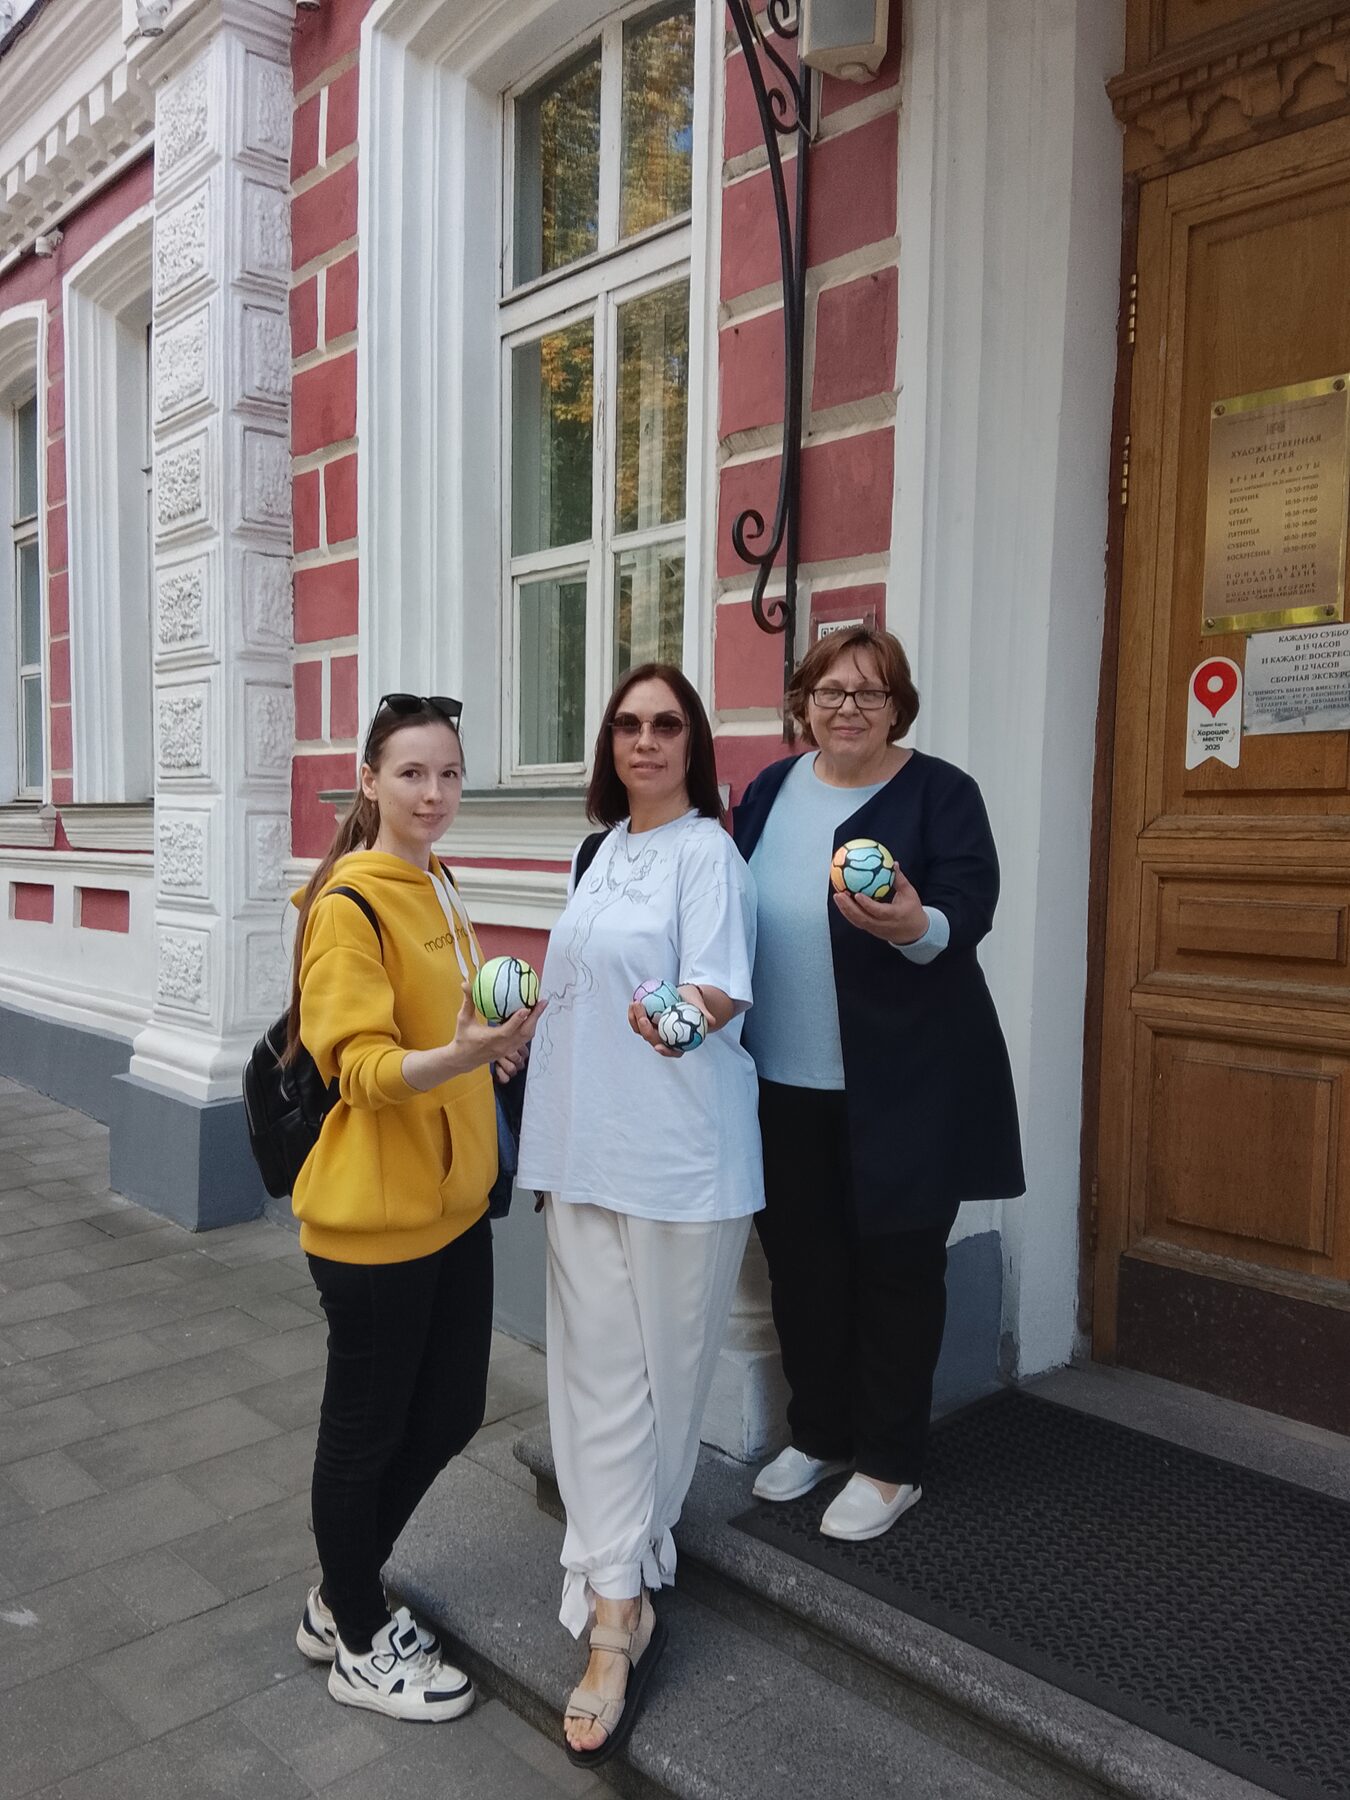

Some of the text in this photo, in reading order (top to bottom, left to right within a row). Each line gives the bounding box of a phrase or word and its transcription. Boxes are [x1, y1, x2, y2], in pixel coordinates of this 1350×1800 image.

[1231, 433, 1322, 459] ХУДОЖЕСТВЕННАЯ
[1255, 449, 1295, 464] ГАЛЕРЕЯ
[1229, 471, 1265, 484] ВРЕМЯ
[1273, 461, 1320, 476] РАБОТЫ
[1229, 493, 1259, 505] ВТОРНИК
[1228, 507, 1249, 516] СРЕДА
[1228, 517, 1253, 527] ЧЕТВЕРГ
[1228, 528, 1260, 538] ПЯТНИЦА
[1227, 539, 1256, 550] СУББОТА
[1226, 549, 1270, 561] ВОСКРЕСЕНЬЕ
[1278, 629, 1350, 643] КАЖДУЮ СУББО
[1303, 643, 1310, 651] 15
[1312, 640, 1341, 650] ЧАСОВ
[1261, 657, 1268, 665] И
[1269, 653, 1305, 663] КАЖДОЕ
[1302, 663, 1309, 671] 12
[1310, 661, 1340, 670] ЧАСОВ
[1270, 673, 1310, 683] СБОРНАЯ
[1197, 728, 1230, 737] Хорошее
